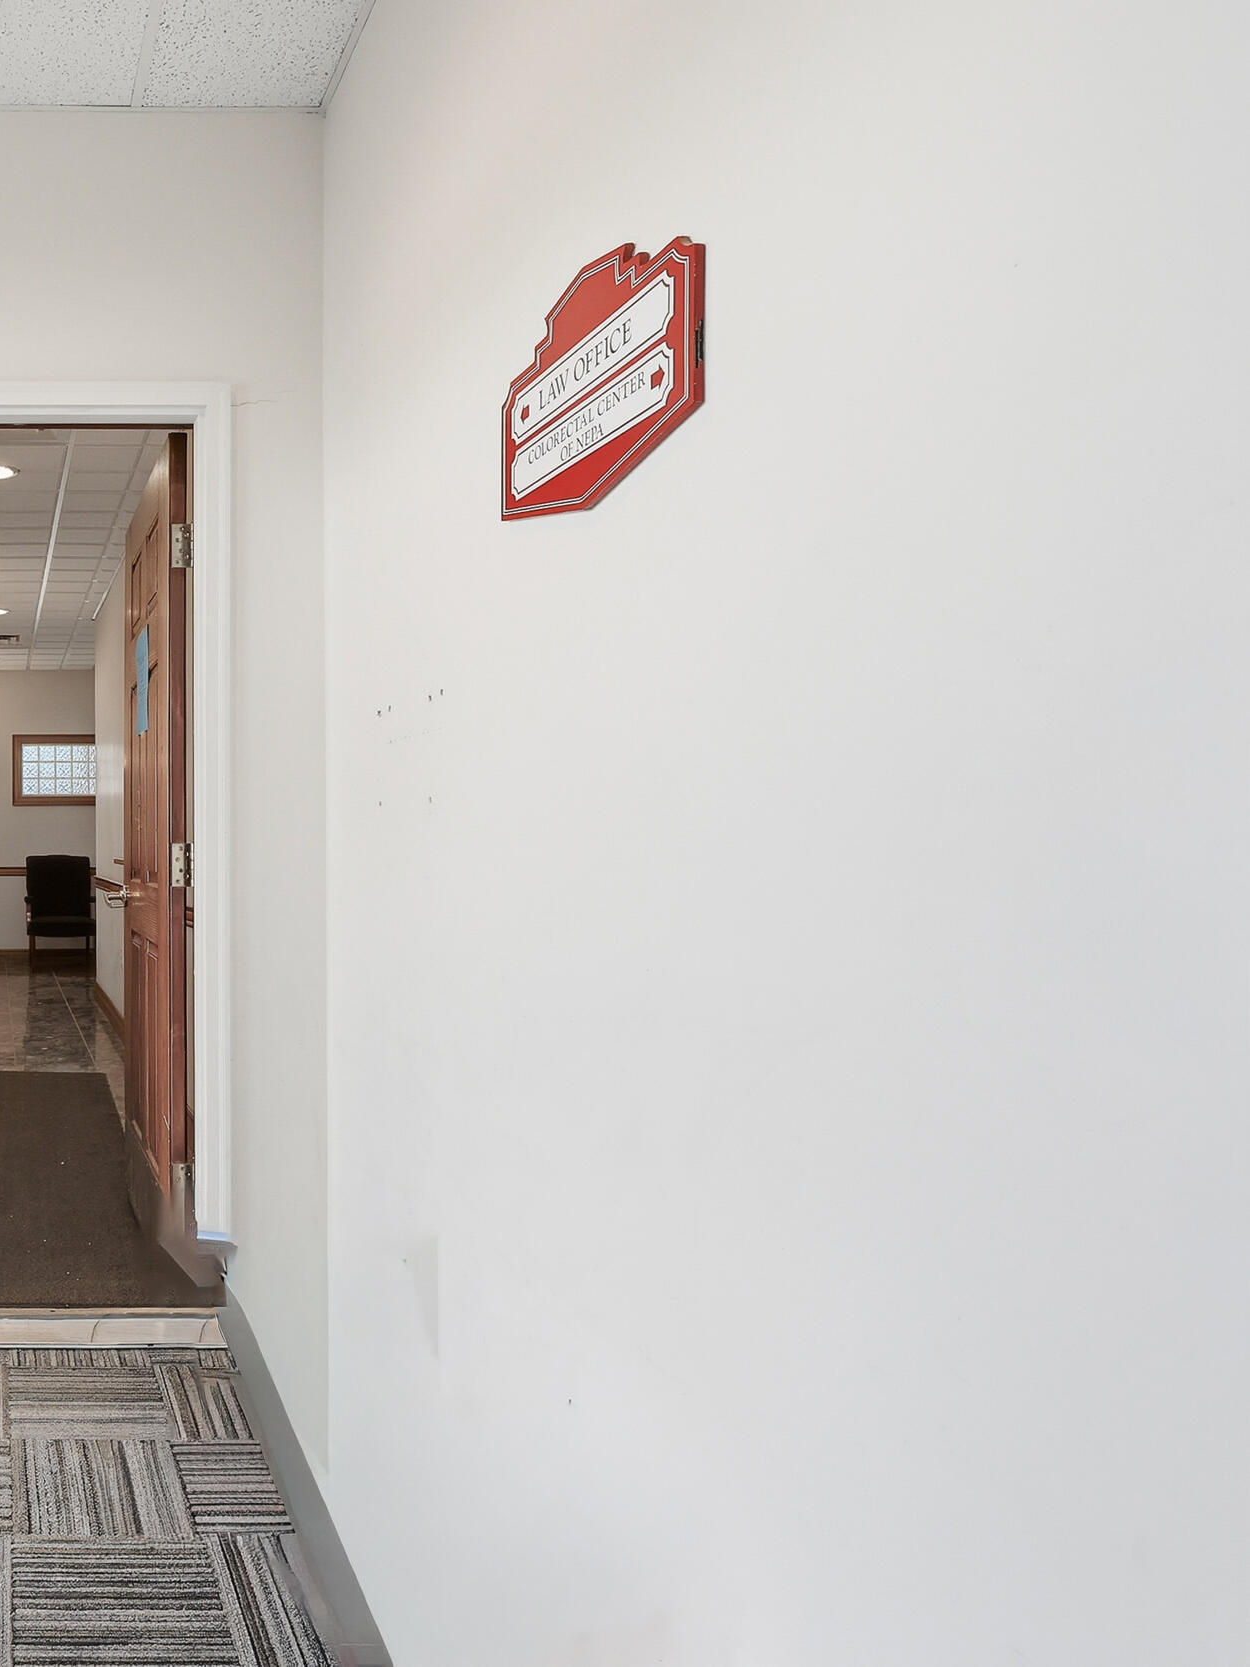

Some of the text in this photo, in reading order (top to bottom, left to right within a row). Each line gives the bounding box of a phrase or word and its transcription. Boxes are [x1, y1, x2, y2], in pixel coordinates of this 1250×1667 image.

[538, 318, 633, 411] LAW OFFICE
[527, 371, 646, 465] COLORECTAL CENTER
[559, 423, 605, 462] OF NEPA
